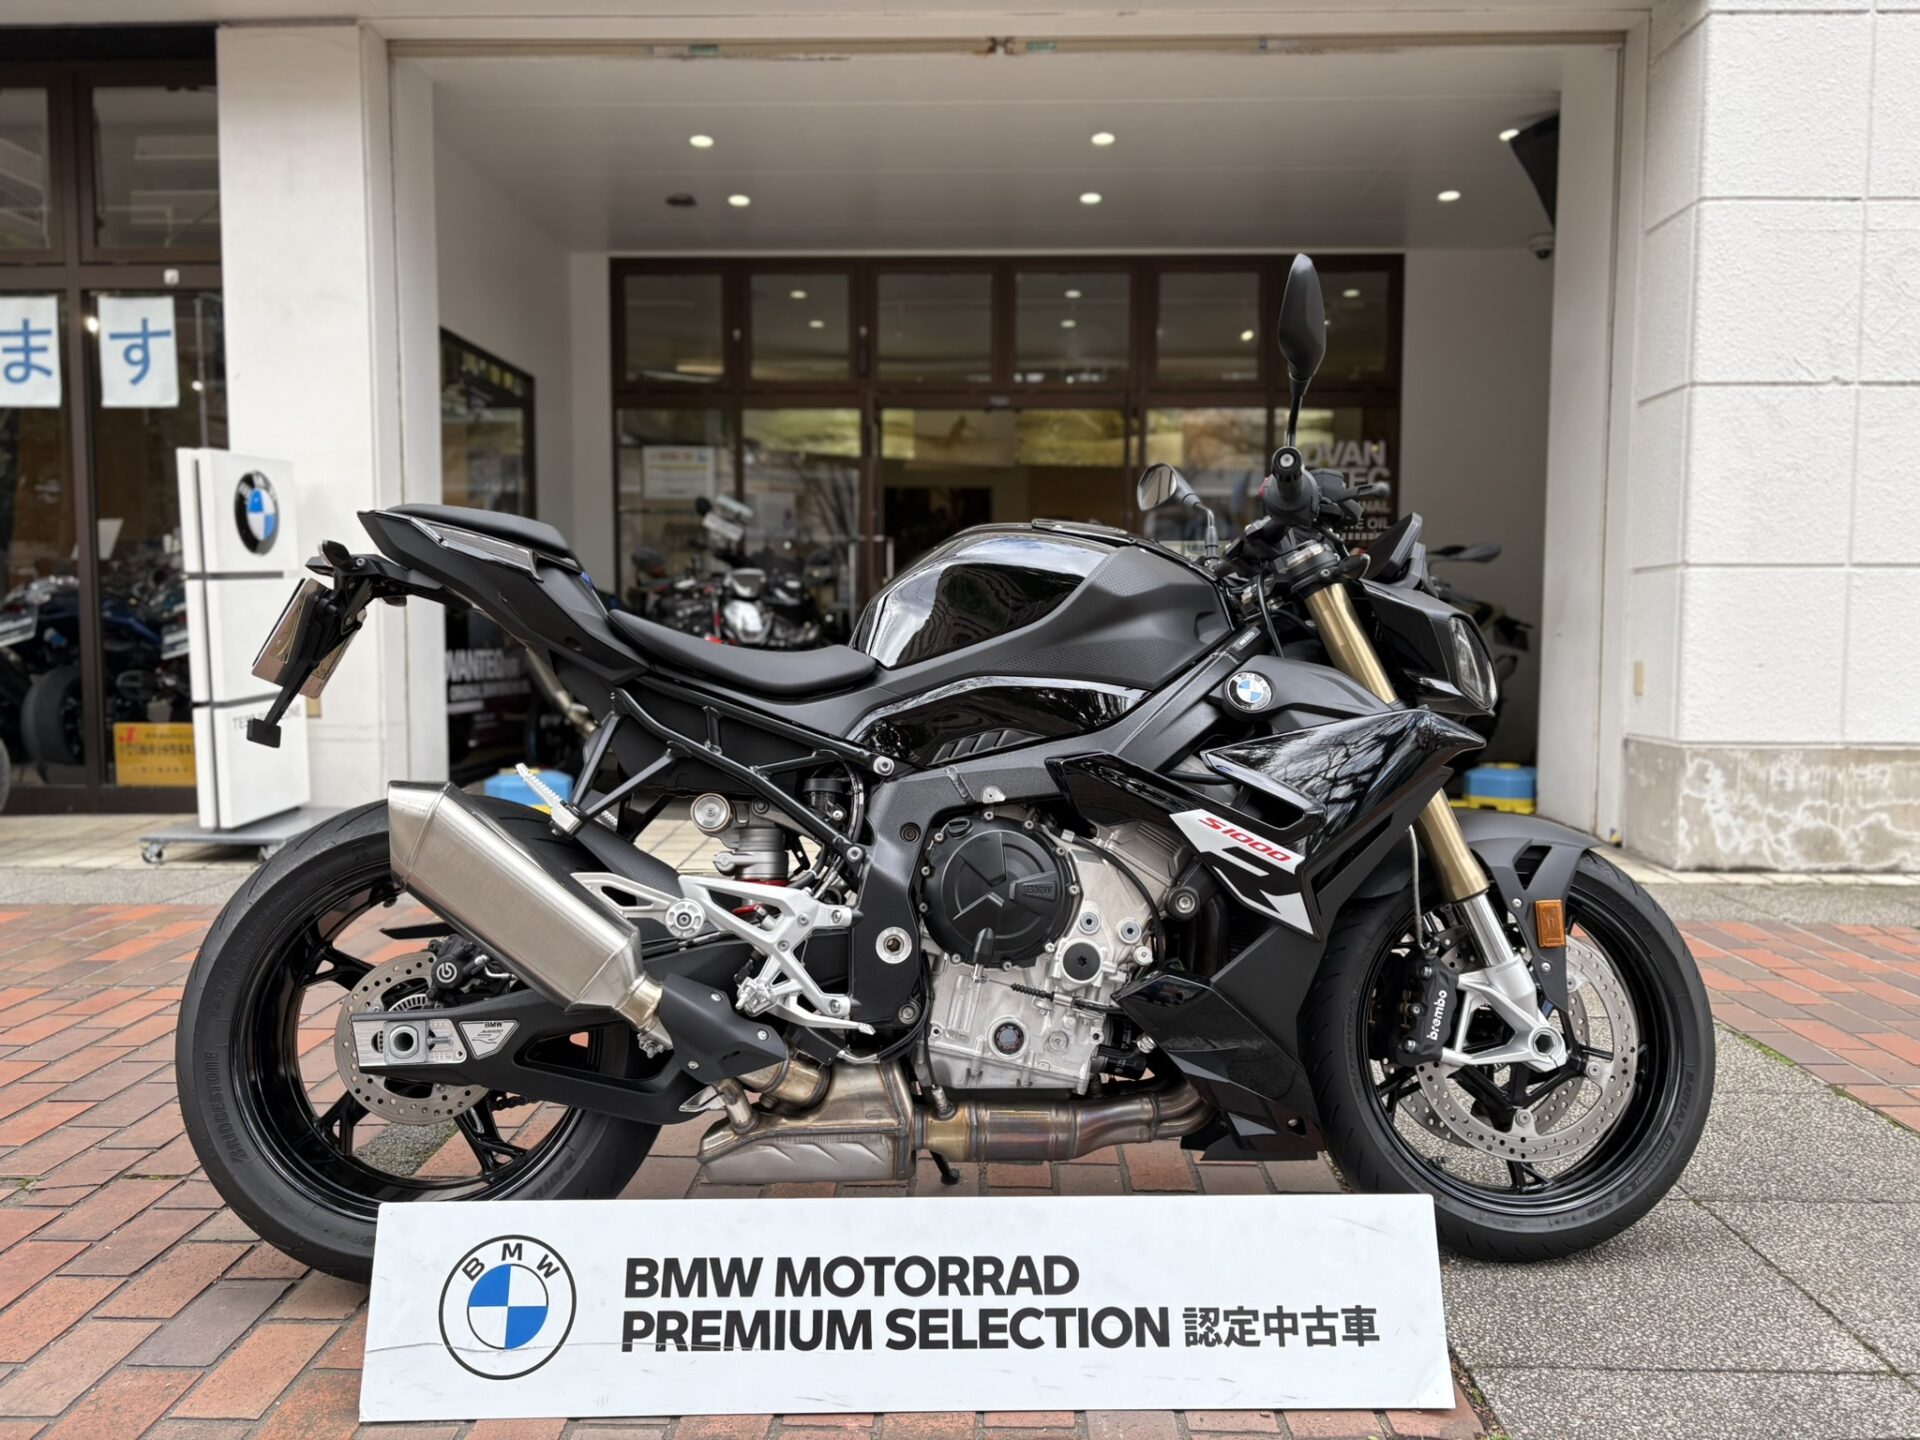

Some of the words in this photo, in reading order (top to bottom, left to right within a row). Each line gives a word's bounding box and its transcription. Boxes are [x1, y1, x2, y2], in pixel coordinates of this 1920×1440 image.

[1303, 440, 1387, 467] DVAN
[1199, 817, 1292, 862] S1000
[1426, 989, 1448, 1041] brembo
[461, 1241, 561, 1281] BMW
[624, 1257, 764, 1298] BMW
[774, 1255, 1080, 1298] MOTORRAD
[621, 1309, 873, 1353] PREMIUM
[885, 1306, 1170, 1351] SELECTION
[1183, 1305, 1380, 1348] 認定中古車
